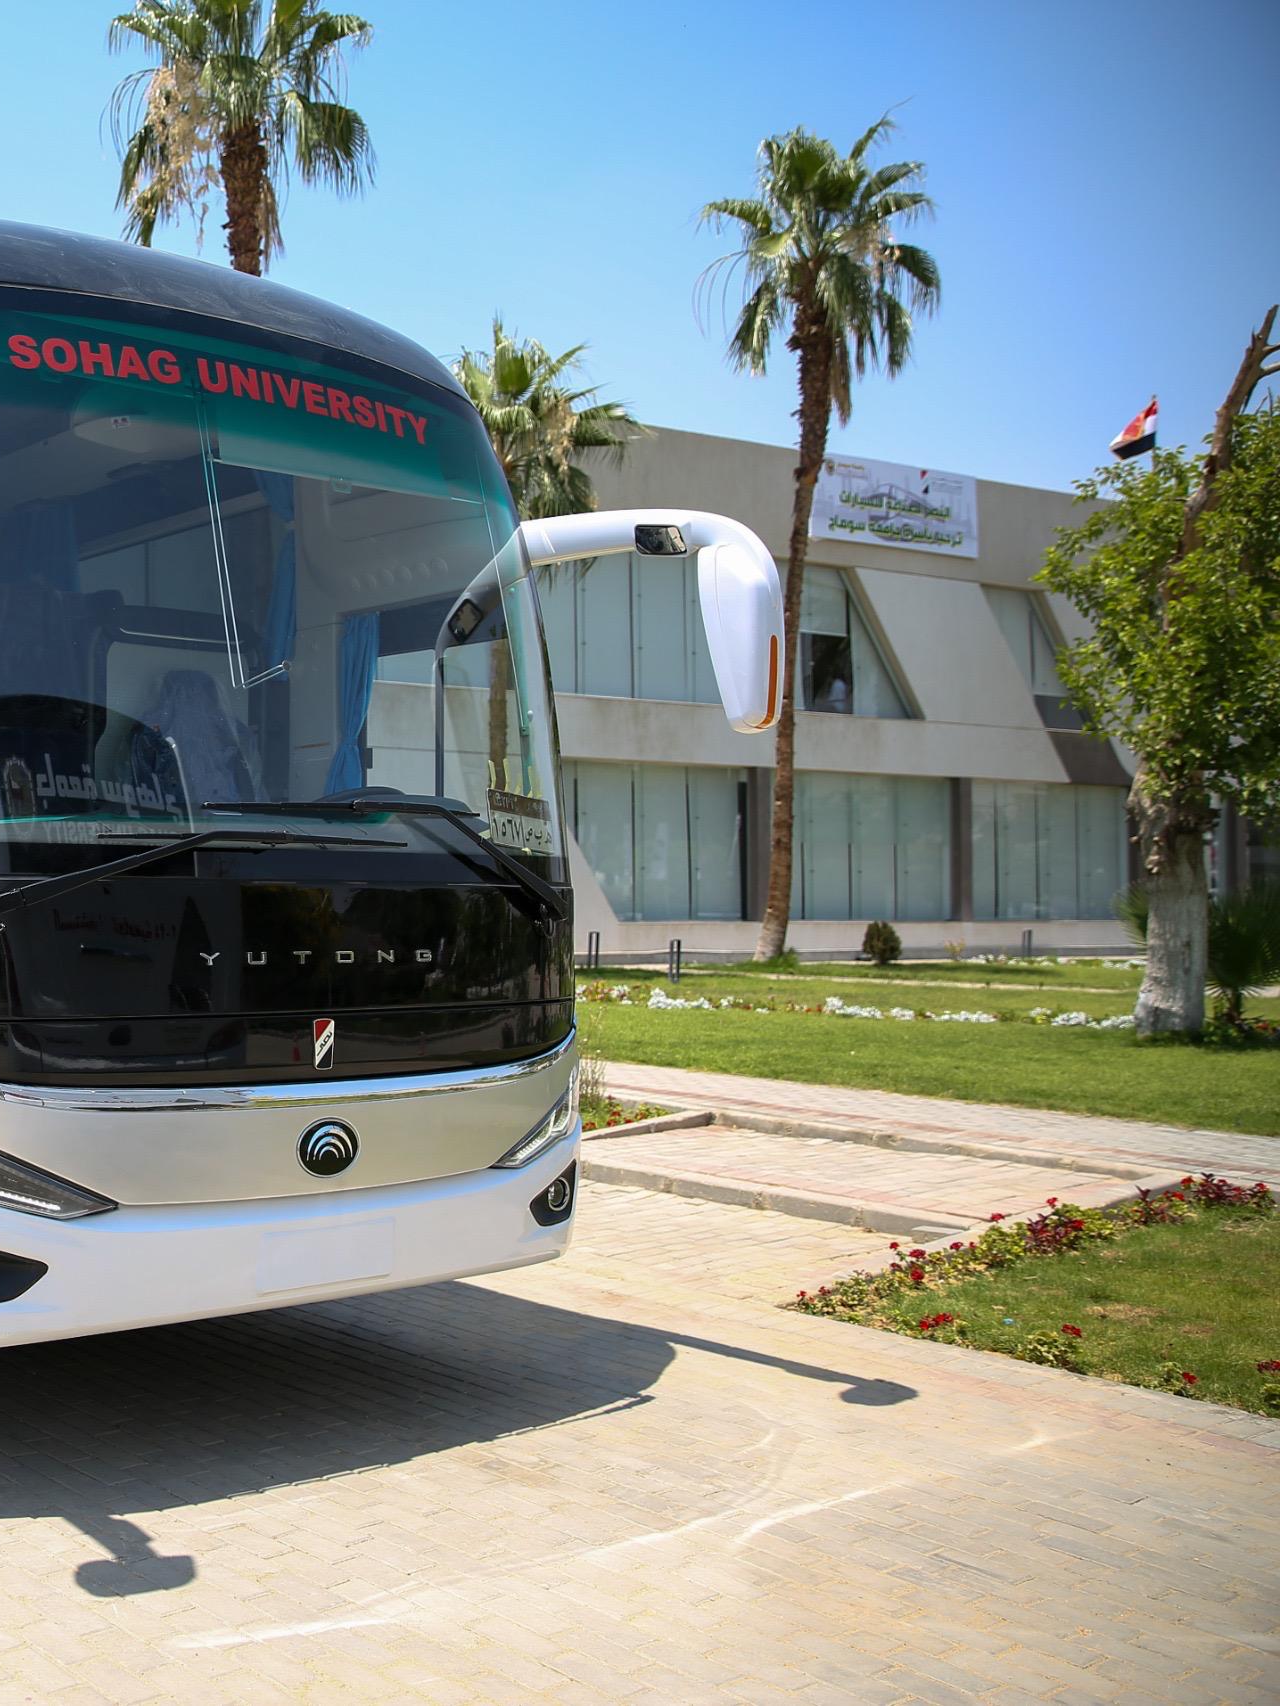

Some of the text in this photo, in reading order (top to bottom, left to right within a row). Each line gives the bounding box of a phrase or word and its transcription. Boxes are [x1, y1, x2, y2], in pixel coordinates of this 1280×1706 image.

[8, 334, 428, 445] SOHAG UNIVERSITY
[200, 949, 432, 966] YUTONG
